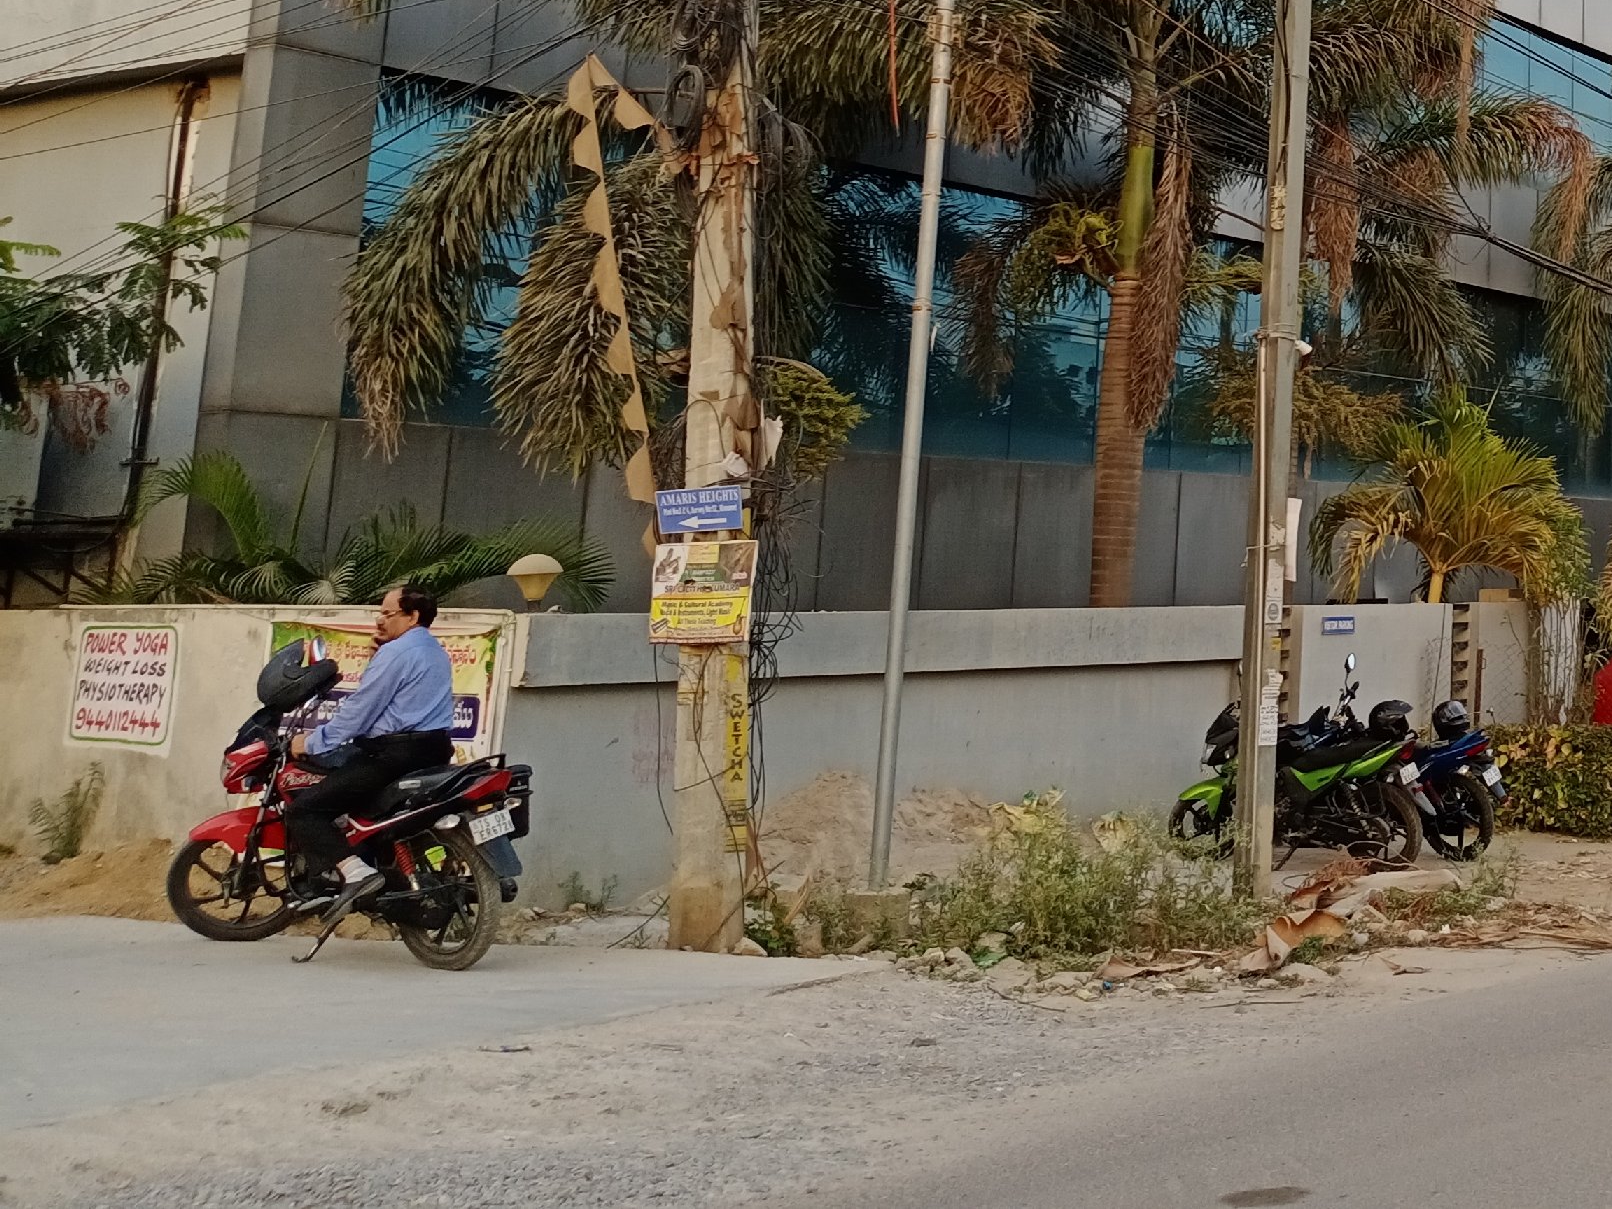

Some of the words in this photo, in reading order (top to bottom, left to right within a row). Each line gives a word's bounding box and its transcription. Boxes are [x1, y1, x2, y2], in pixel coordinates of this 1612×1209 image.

[660, 492, 698, 506] AMARIS
[699, 489, 739, 503] HEIGHTS
[84, 632, 127, 656] POWER
[133, 632, 169, 656] YOGA
[84, 657, 131, 677] WEIGHT
[131, 660, 166, 677] LOSS
[76, 679, 167, 709] PHYSIOTHERAPY
[75, 707, 161, 738] 9440112444
[728, 692, 745, 782] SWETCHA
